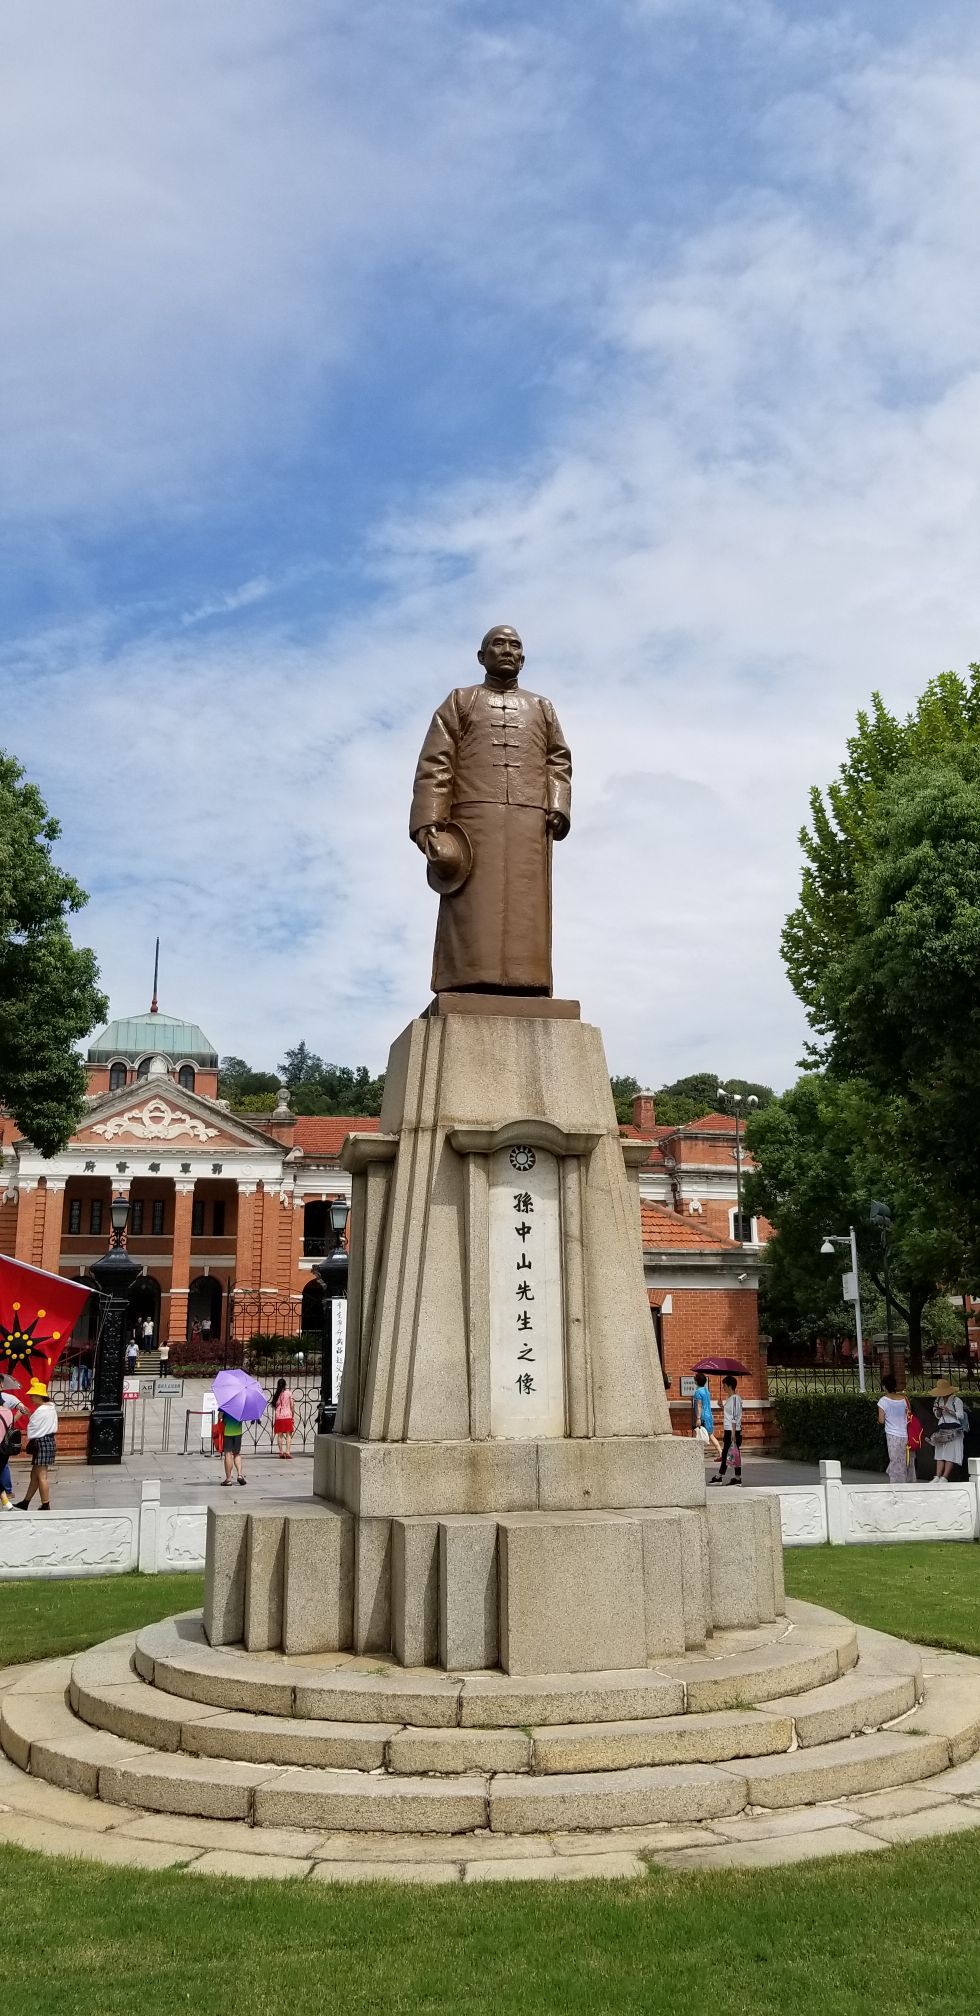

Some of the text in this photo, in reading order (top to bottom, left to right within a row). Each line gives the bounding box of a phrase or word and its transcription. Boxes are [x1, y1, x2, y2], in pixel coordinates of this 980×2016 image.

[513, 1191, 537, 1395] 孫中山先生之像
